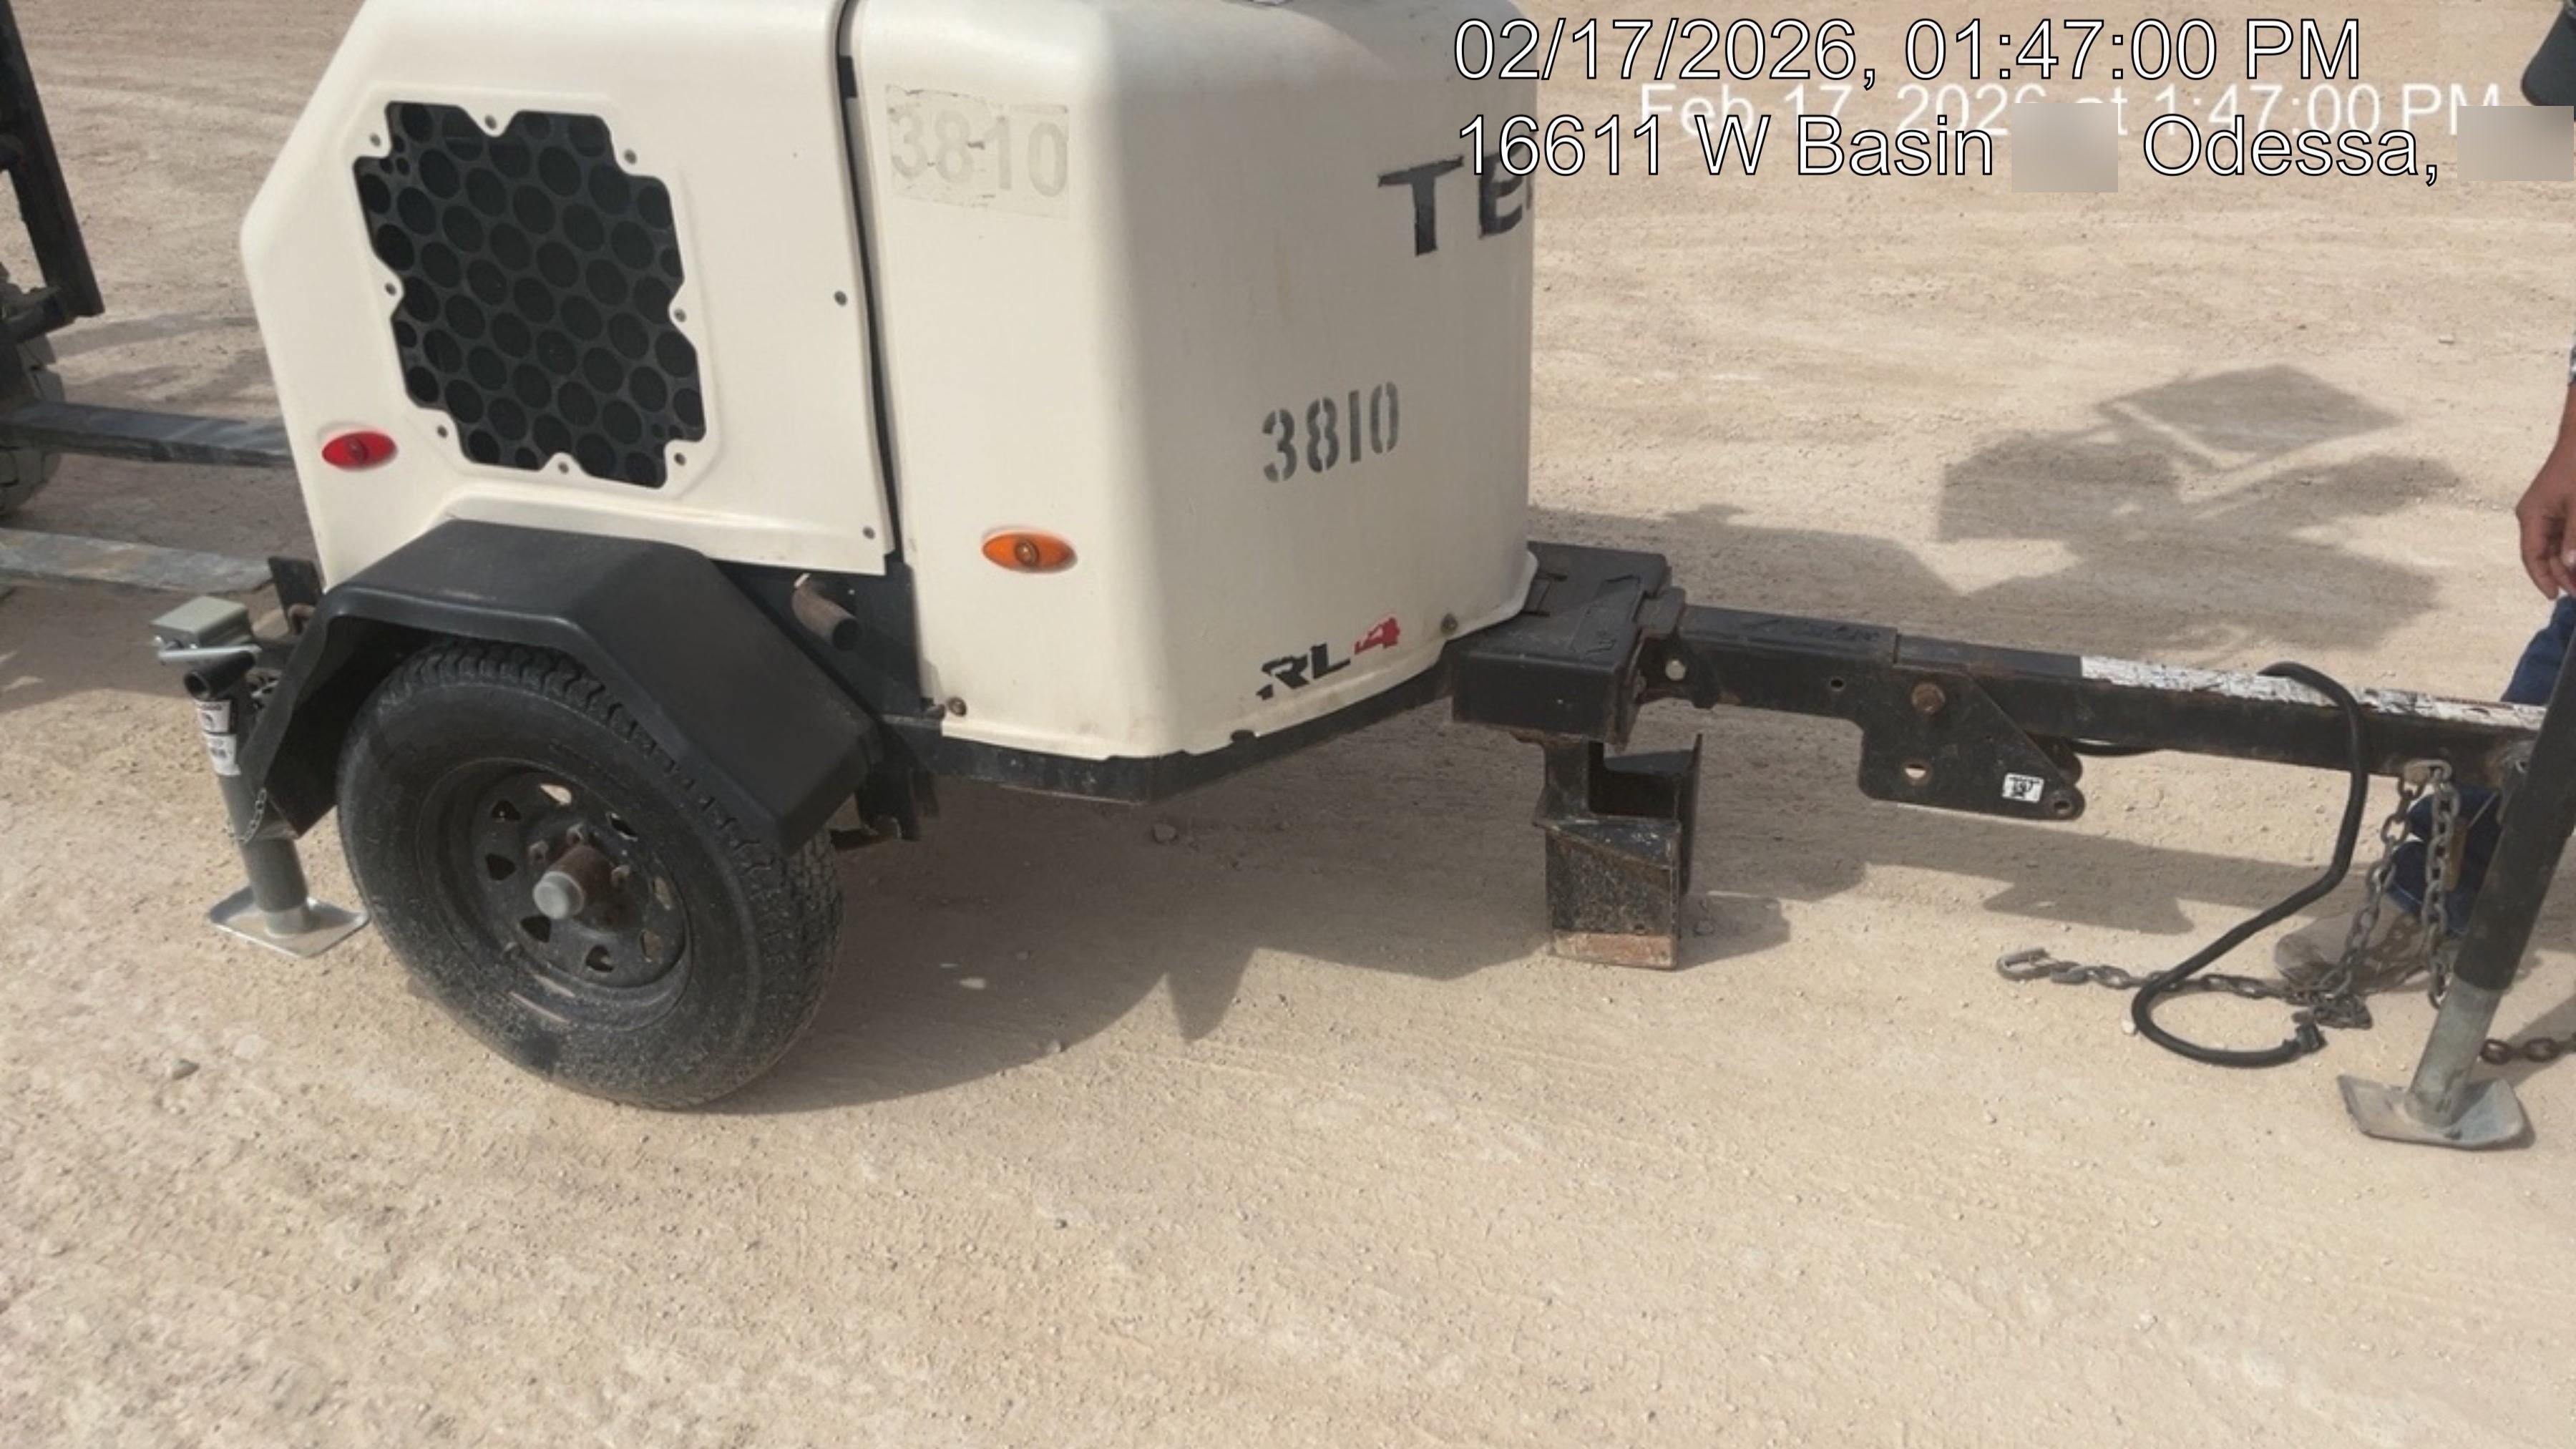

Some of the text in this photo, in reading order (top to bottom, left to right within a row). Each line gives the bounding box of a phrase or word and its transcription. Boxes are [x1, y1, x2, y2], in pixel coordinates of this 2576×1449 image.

[890, 102, 1068, 197] 3810
[1377, 132, 1536, 256] TE
[1262, 381, 1400, 484] 3810
